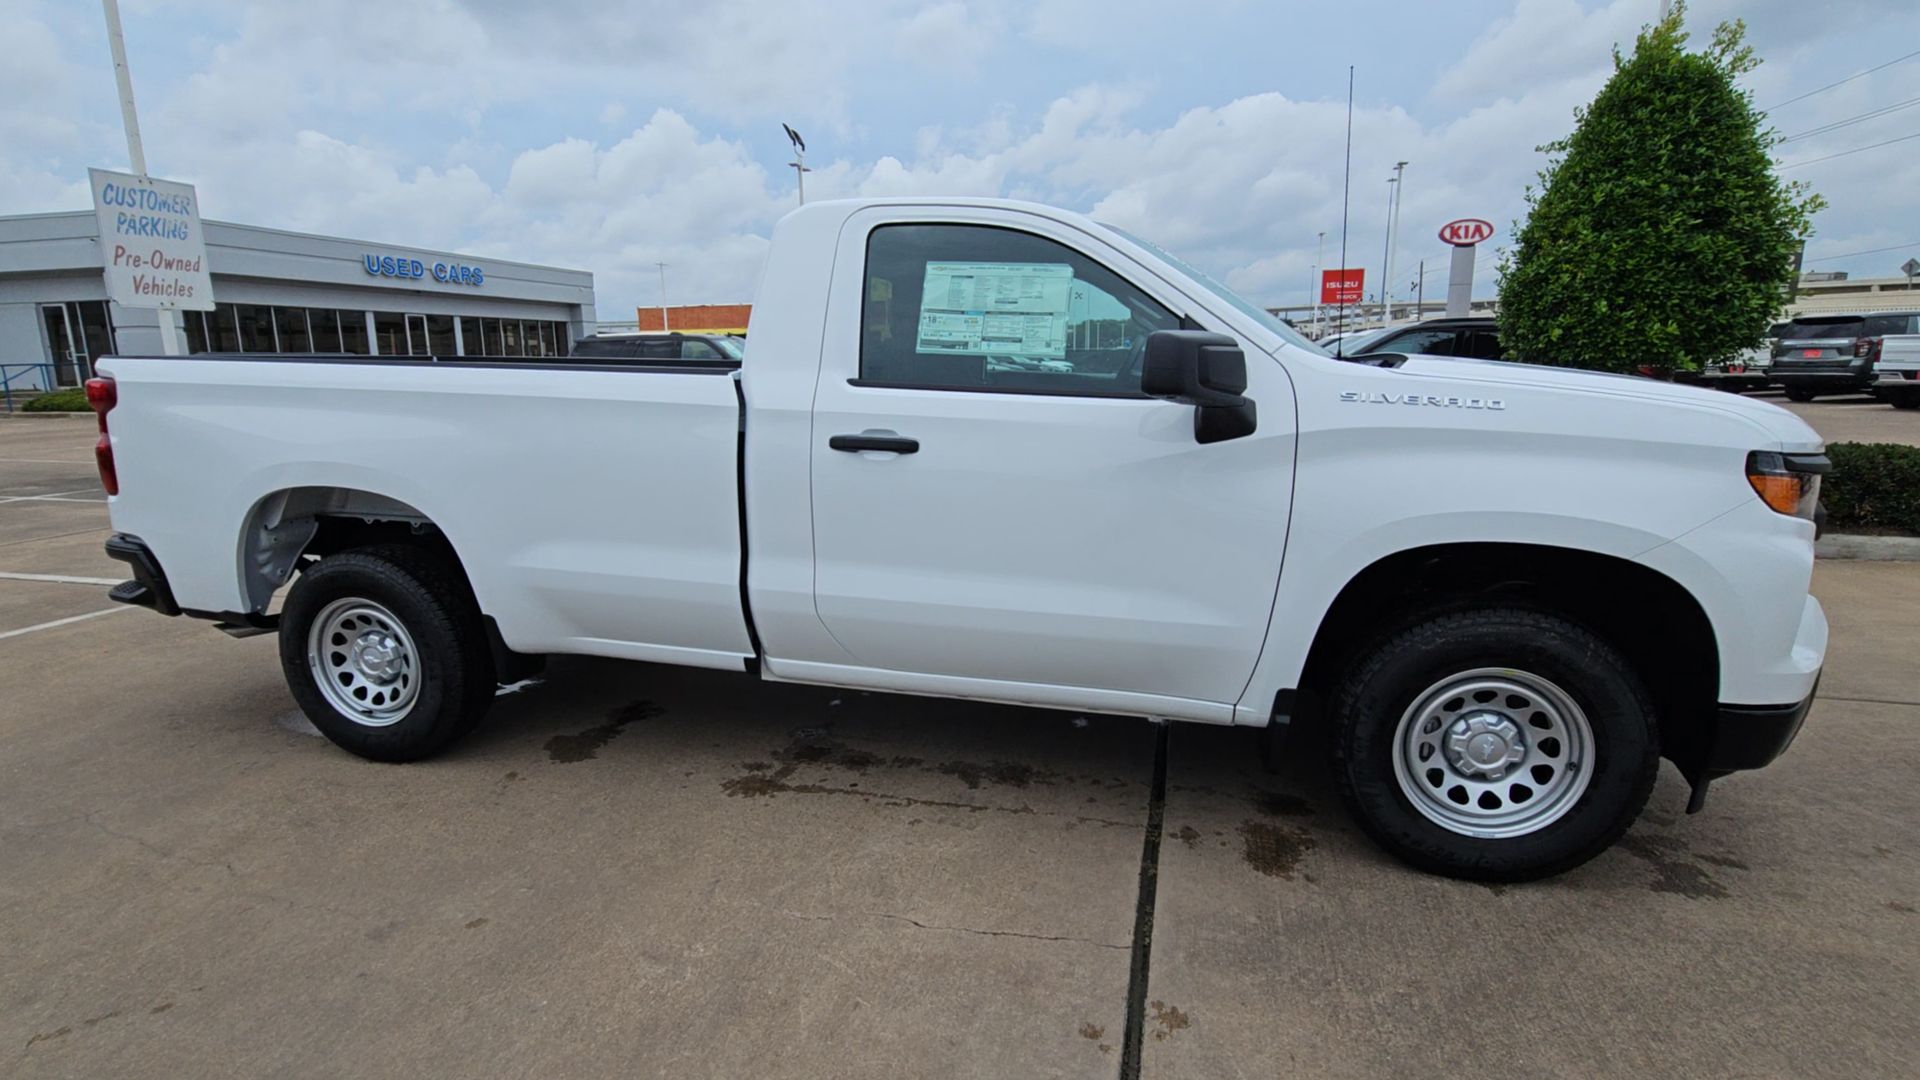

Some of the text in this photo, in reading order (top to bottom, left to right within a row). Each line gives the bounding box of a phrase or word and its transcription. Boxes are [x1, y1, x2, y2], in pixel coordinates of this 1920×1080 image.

[102, 183, 190, 215] CUSTOMER
[116, 211, 188, 240] PARKING
[1450, 224, 1484, 239] KIA
[113, 245, 201, 272] Pre-Owned
[365, 254, 484, 285] USED CARS
[132, 274, 193, 298] Vehicles
[1340, 392, 1506, 411] SILVERADO
